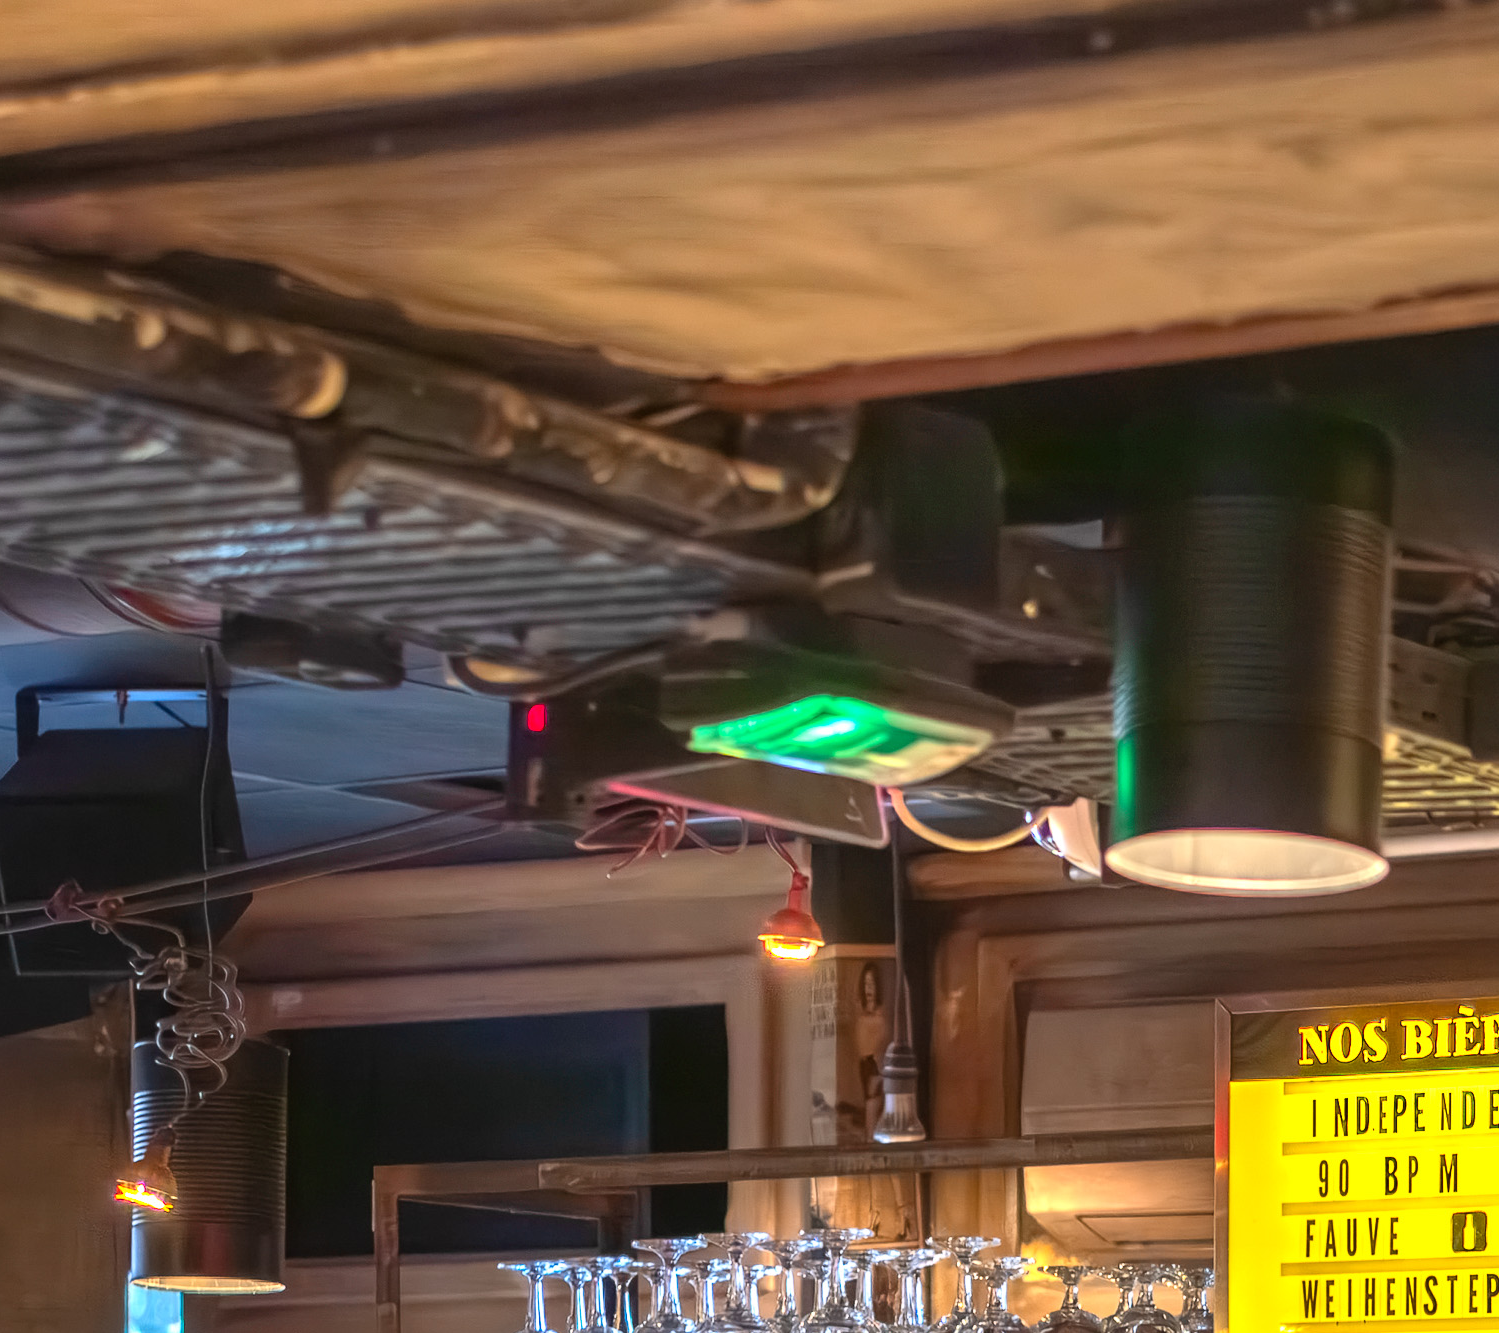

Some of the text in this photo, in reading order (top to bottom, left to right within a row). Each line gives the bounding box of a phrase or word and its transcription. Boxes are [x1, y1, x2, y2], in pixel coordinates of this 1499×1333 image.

[1298, 1018, 1390, 1067] NOS
[1318, 1158, 1350, 1198] 90
[1384, 1153, 1459, 1196] BPM
[1305, 1216, 1399, 1258] FAUVE
